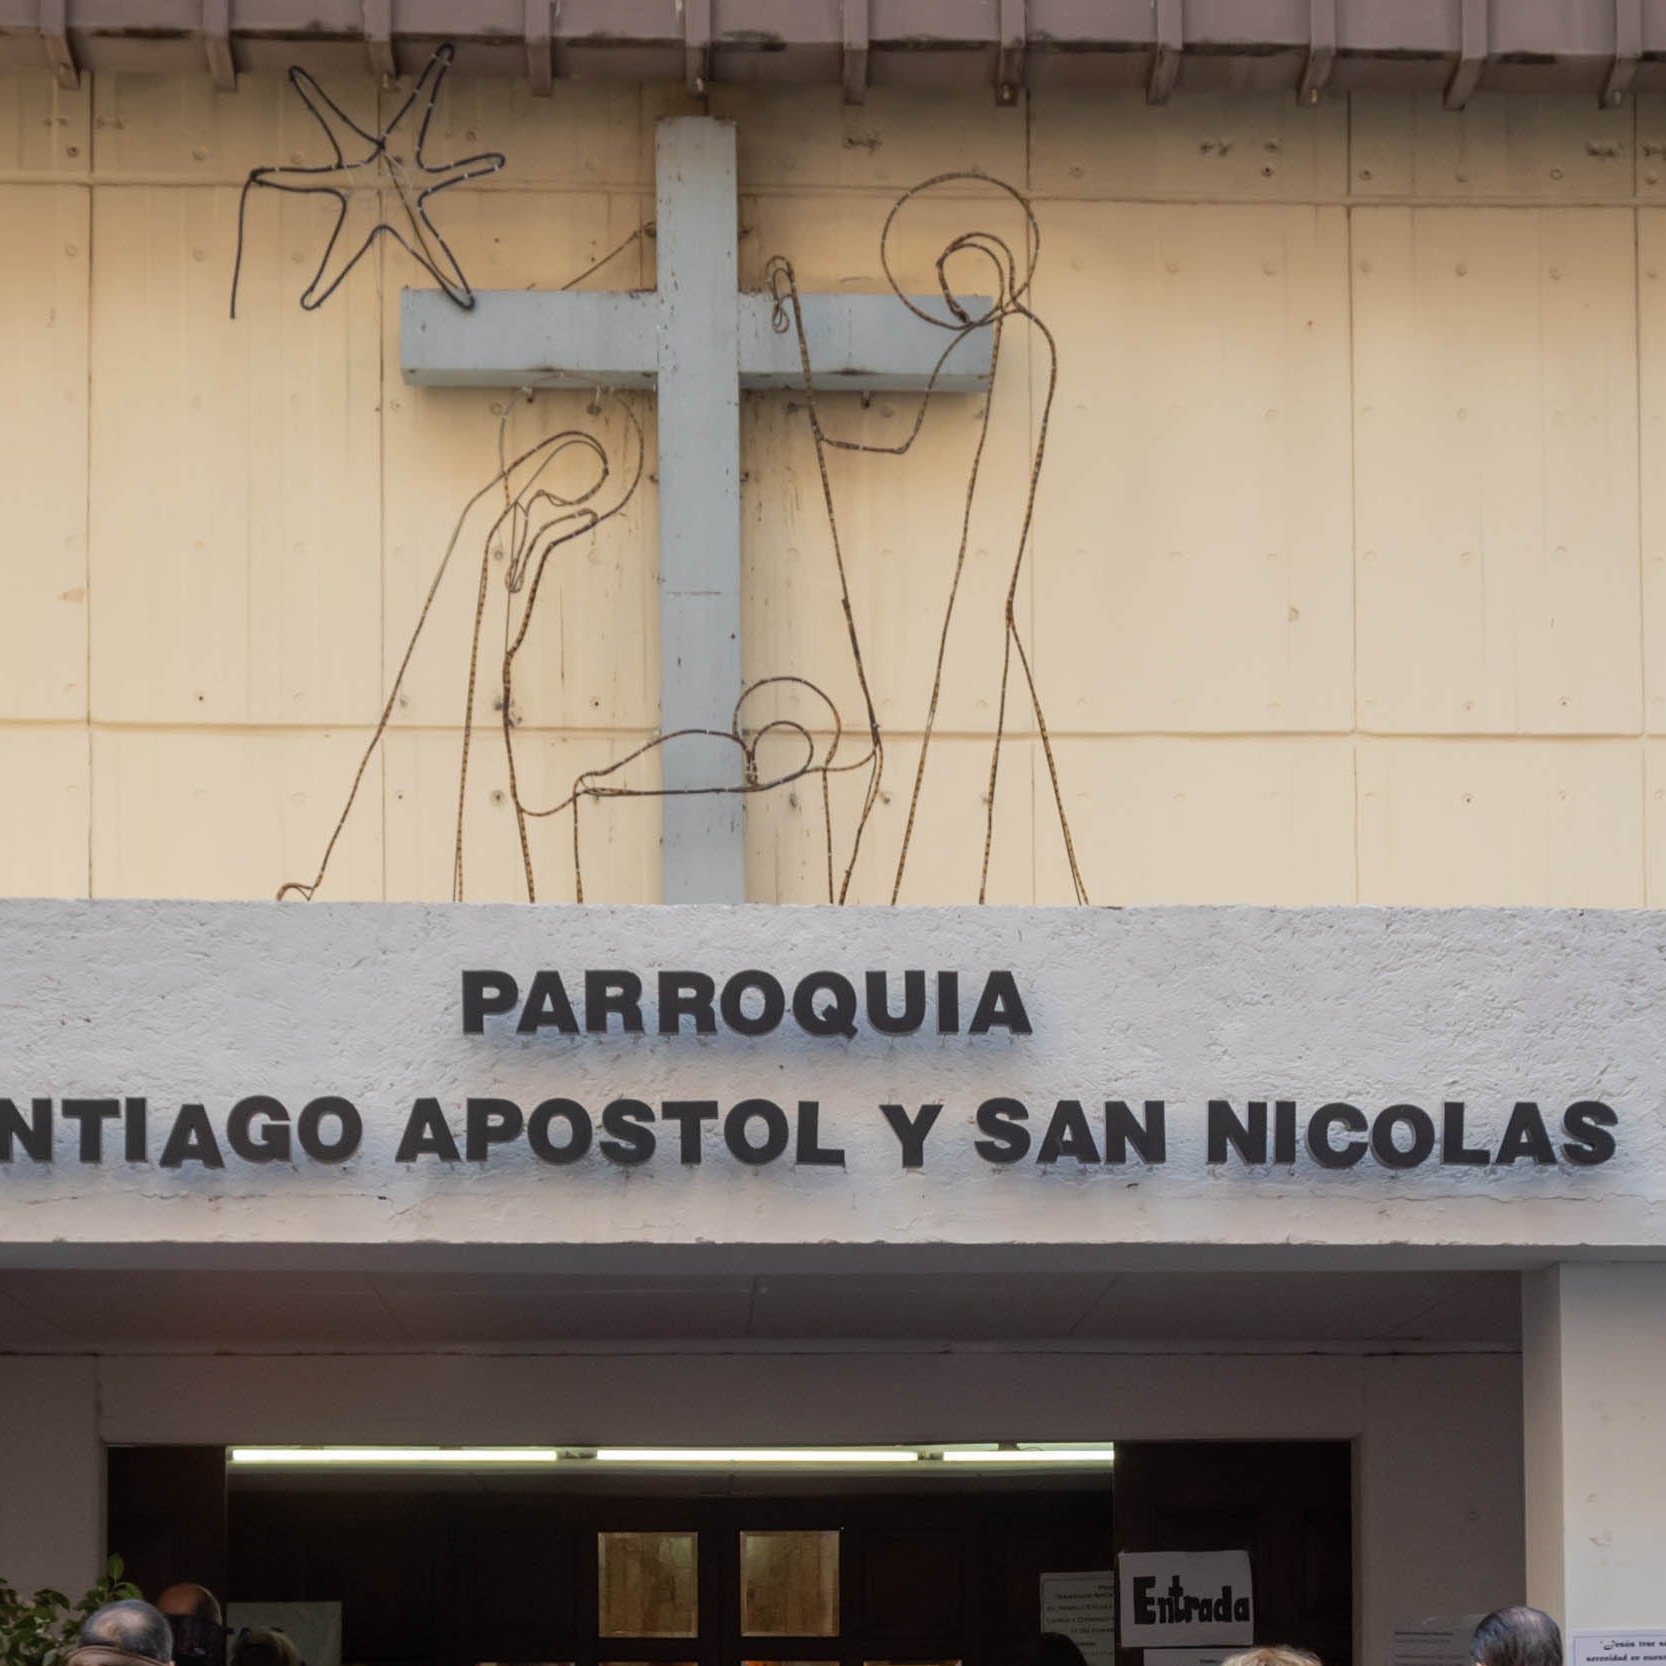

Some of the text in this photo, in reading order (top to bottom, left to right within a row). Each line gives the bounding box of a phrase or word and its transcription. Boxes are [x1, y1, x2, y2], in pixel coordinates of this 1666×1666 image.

[461, 969, 1034, 1041] PARROQUIA
[394, 1096, 847, 1170] APOSTOL
[878, 1103, 945, 1169] Y
[973, 1096, 1168, 1167] SAN
[1205, 1099, 1619, 1172] NICOLAS
[1132, 1575, 1250, 1625] Entrada
